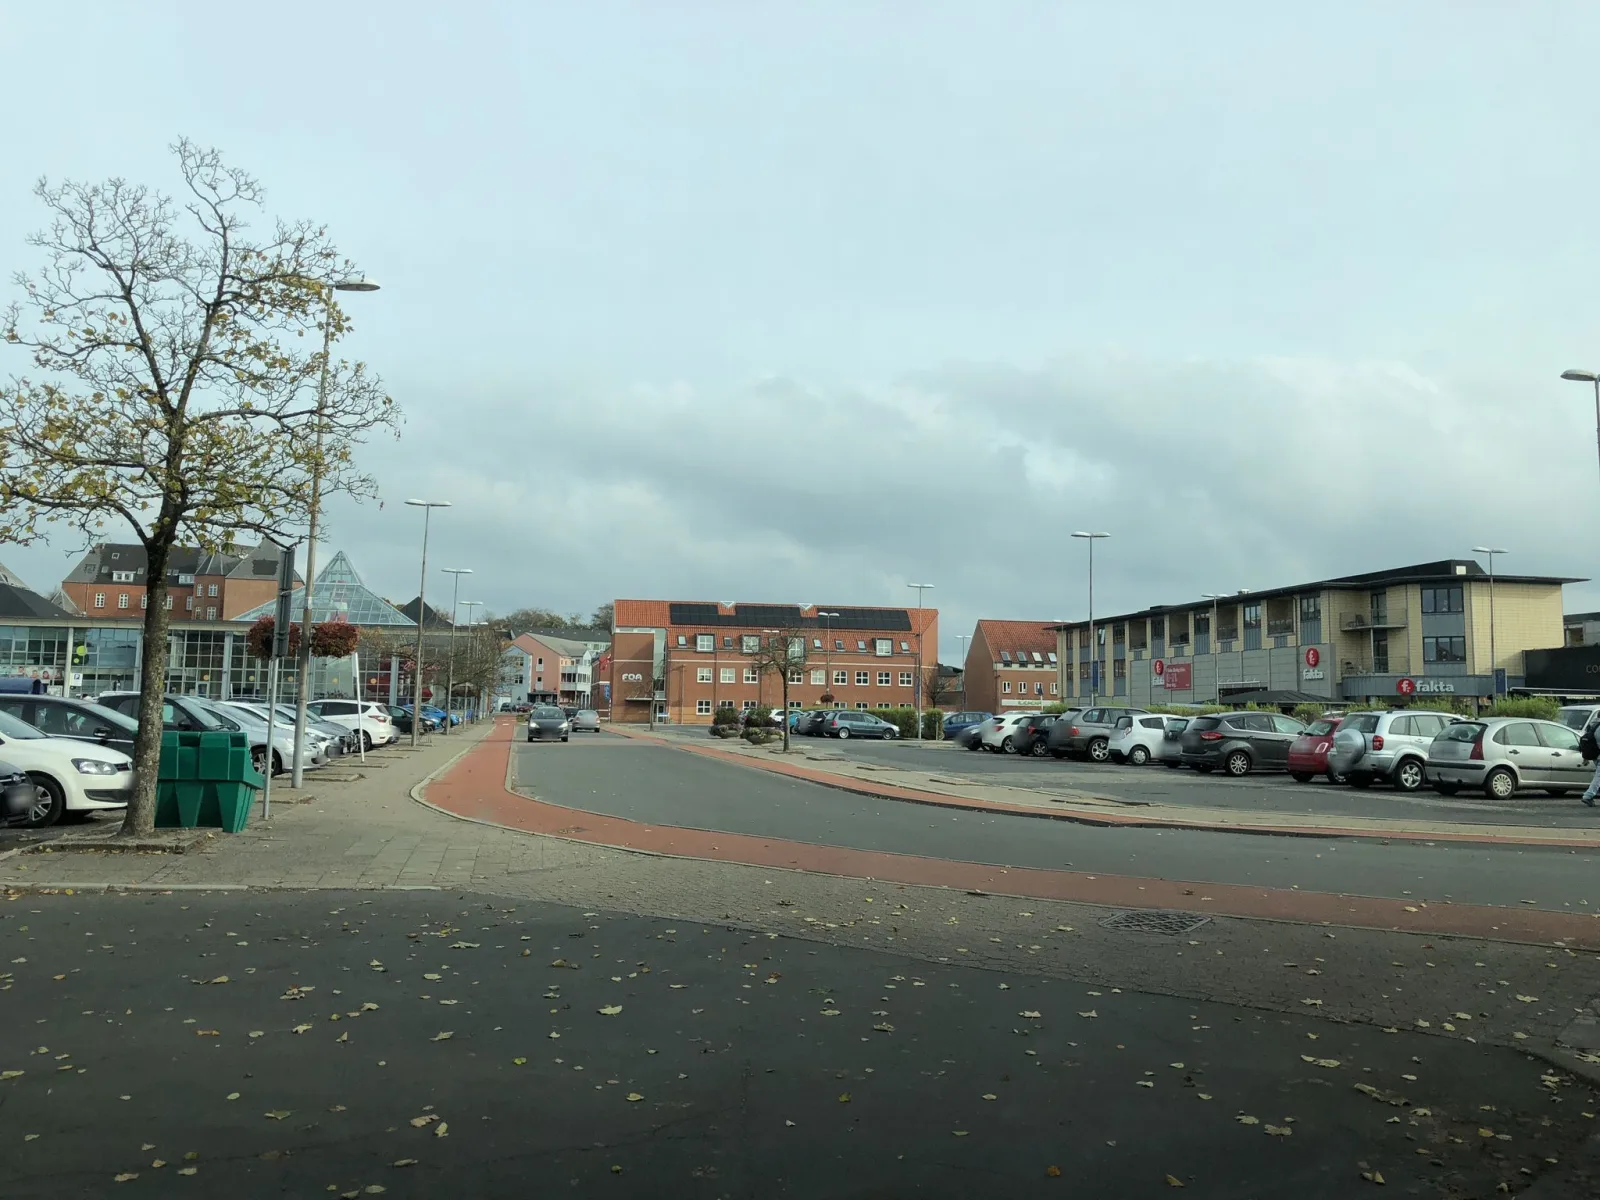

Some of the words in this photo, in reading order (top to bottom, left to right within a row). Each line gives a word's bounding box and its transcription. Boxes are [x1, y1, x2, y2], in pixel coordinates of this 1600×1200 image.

[622, 673, 643, 681] FOA
[1303, 668, 1324, 680] fakta
[1415, 680, 1455, 692] fakta
